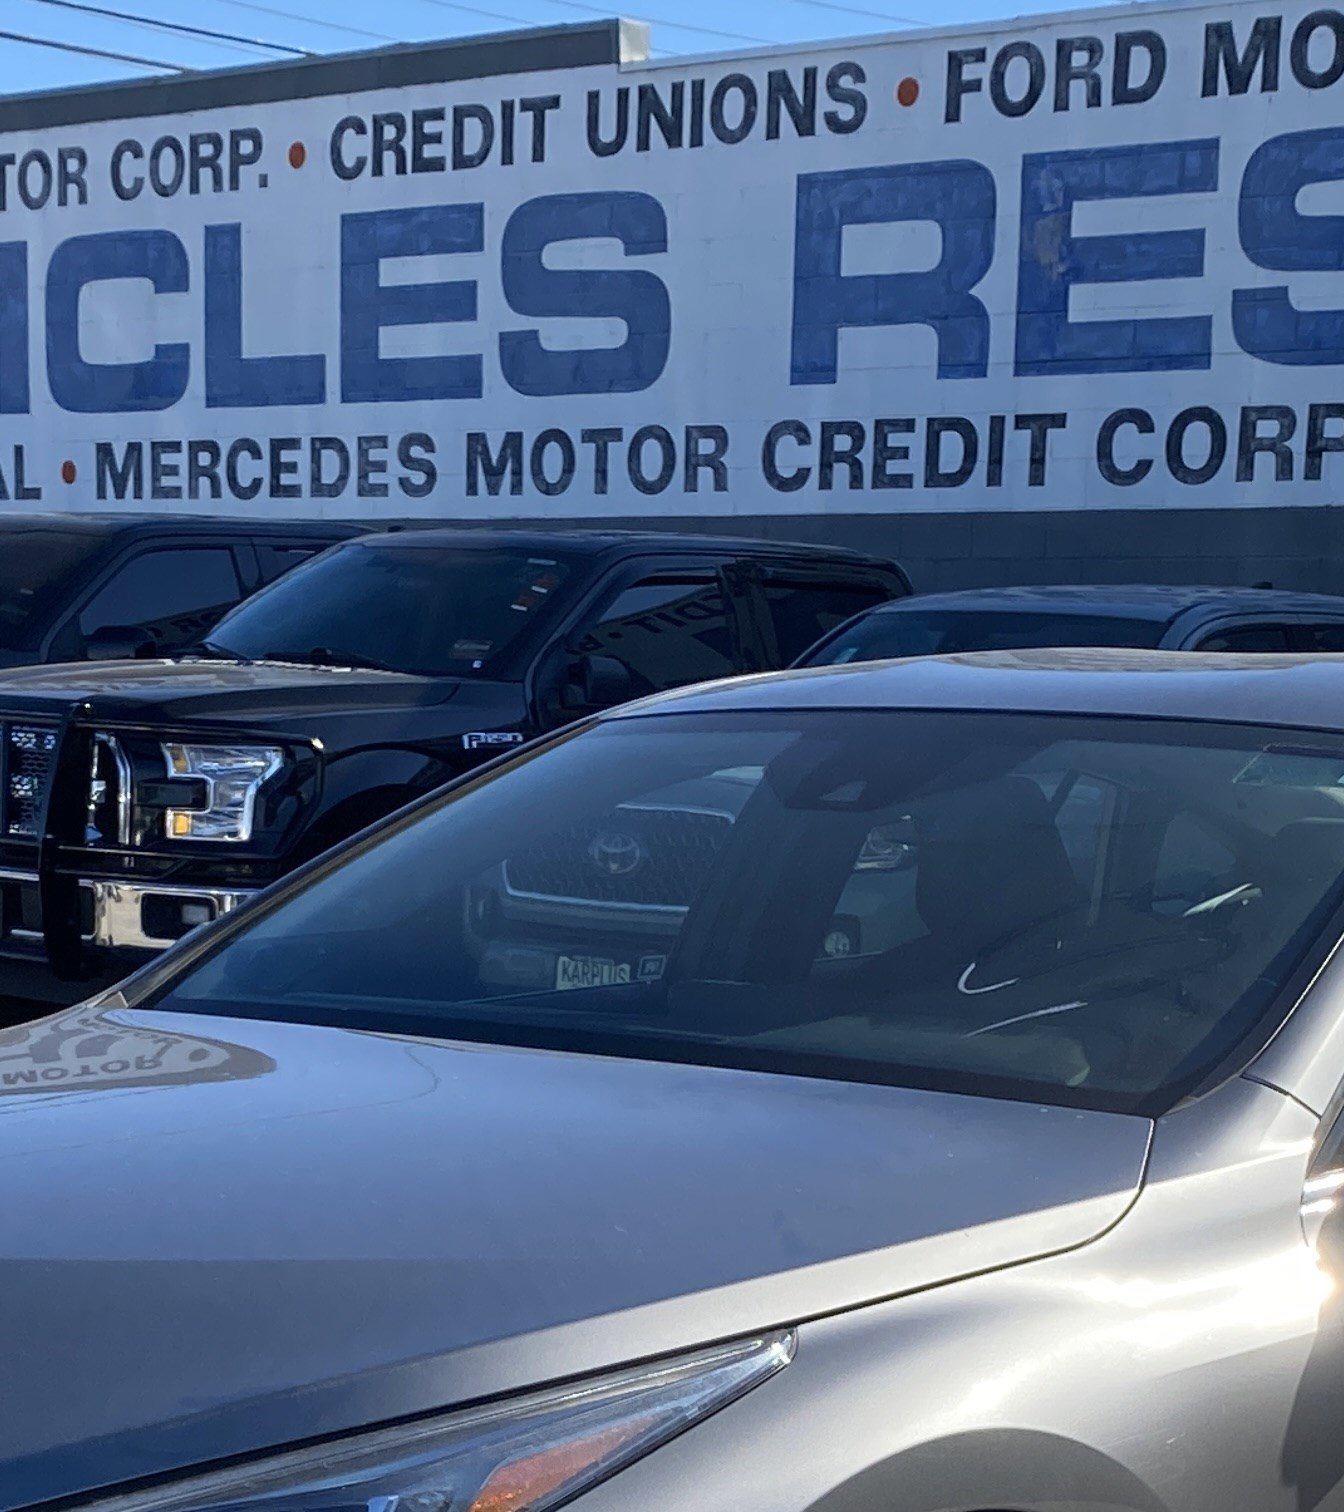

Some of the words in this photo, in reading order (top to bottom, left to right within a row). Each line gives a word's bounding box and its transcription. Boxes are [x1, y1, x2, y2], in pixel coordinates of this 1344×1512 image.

[330, 94, 561, 181] CREDIT
[586, 61, 868, 159] UNIONS
[944, 29, 1167, 124] FORD
[110, 126, 269, 201] CORP.
[95, 430, 438, 501] MERCEDES
[465, 424, 730, 499] MOTOR
[761, 412, 1068, 492] CREDIT
